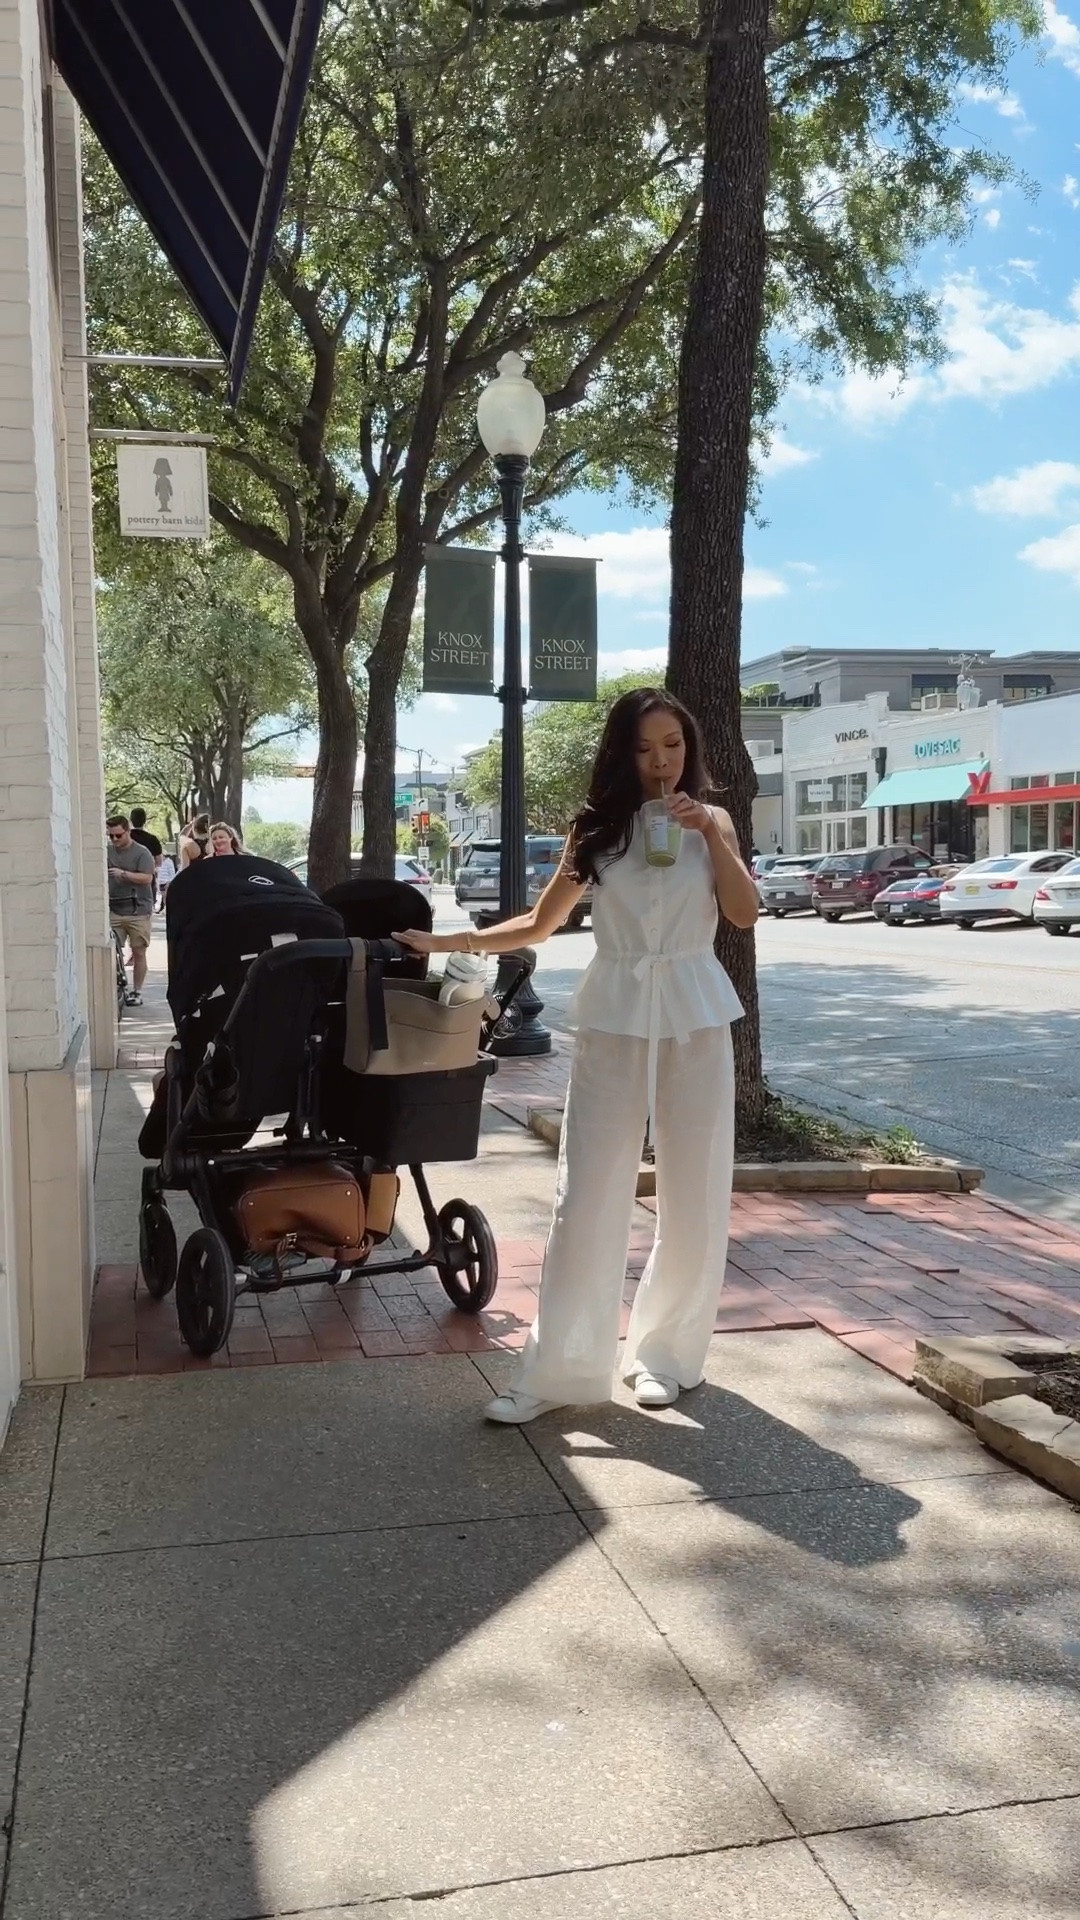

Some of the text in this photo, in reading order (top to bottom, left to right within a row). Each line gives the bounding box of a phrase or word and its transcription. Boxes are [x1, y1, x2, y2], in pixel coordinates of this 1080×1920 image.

[128, 515, 204, 526] pottery barn kids
[438, 631, 482, 649] KNOX
[542, 638, 585, 654] KNOX
[430, 647, 490, 666] STREET
[534, 655, 592, 671] STREET
[914, 739, 961, 758] LOVESAC
